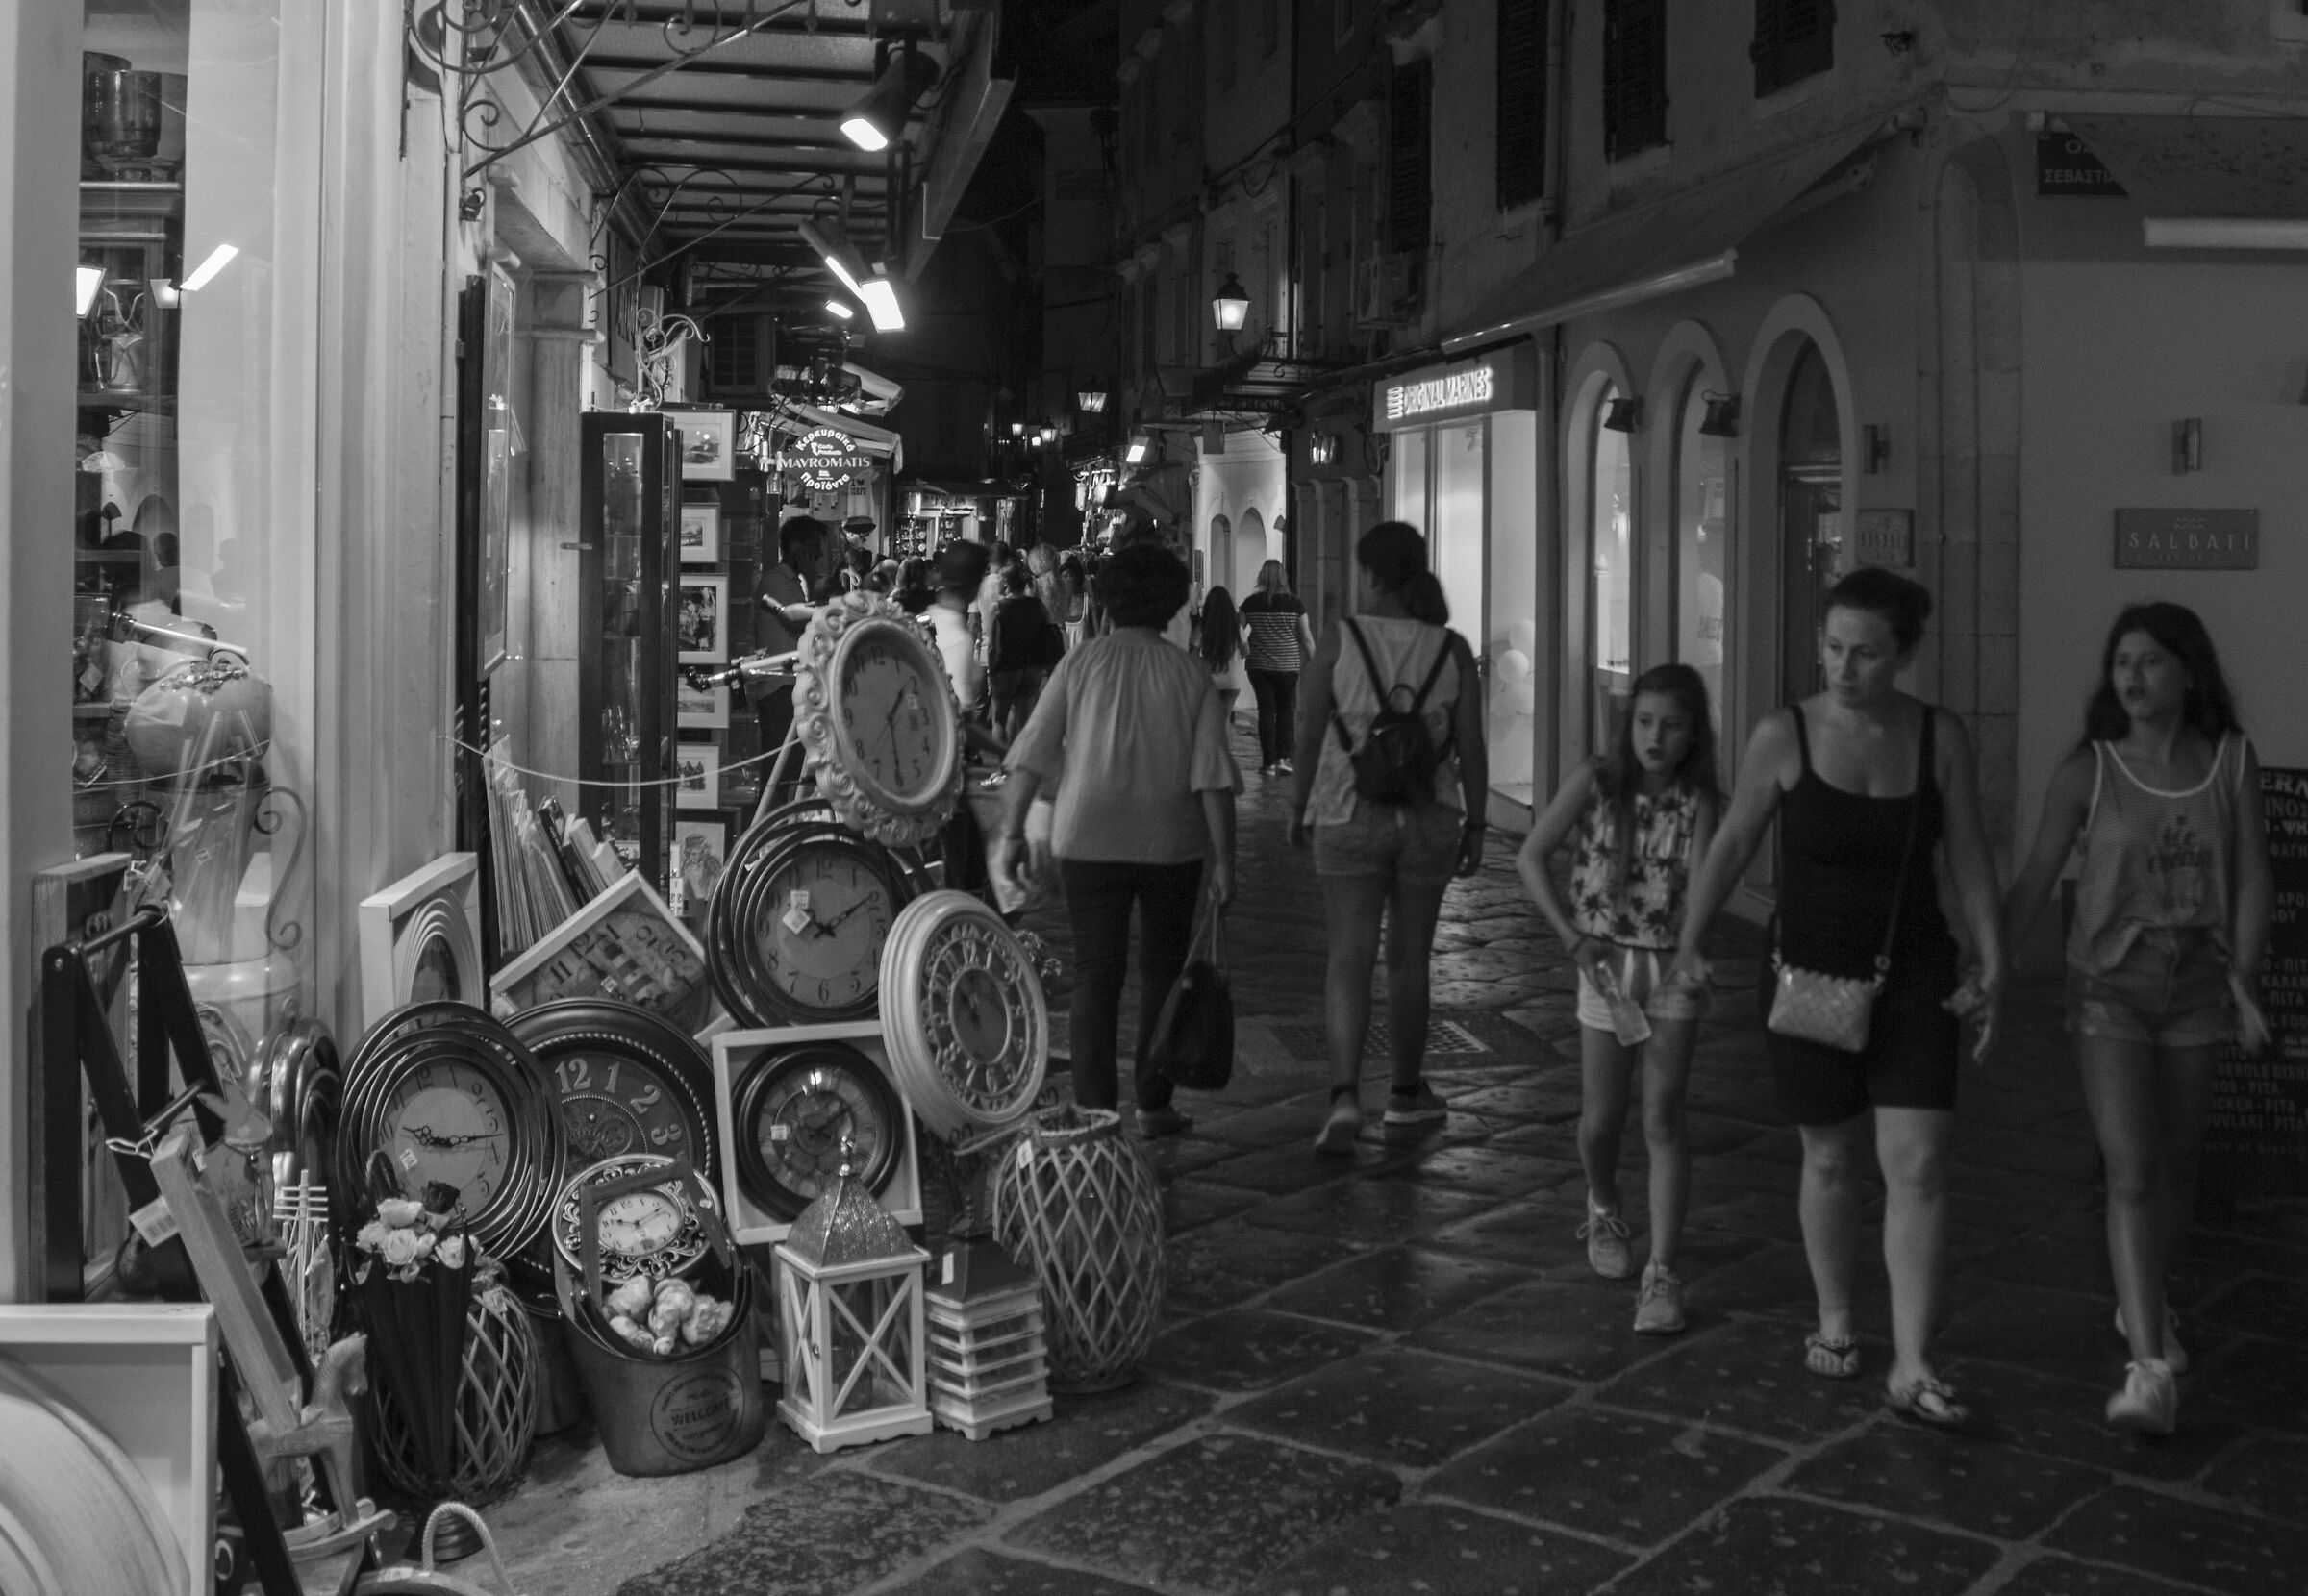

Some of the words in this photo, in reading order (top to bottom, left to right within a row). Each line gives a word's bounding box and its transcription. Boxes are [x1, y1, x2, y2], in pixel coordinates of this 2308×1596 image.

[2044, 168, 2113, 183] ΣΕΒΑΣΤΙ
[781, 457, 871, 469] MAVROMATIS
[2128, 532, 2251, 551] SALBATI
[554, 1059, 591, 1094] 12
[604, 1061, 620, 1094] 1
[629, 1085, 661, 1115] 2
[651, 1124, 682, 1146] 3
